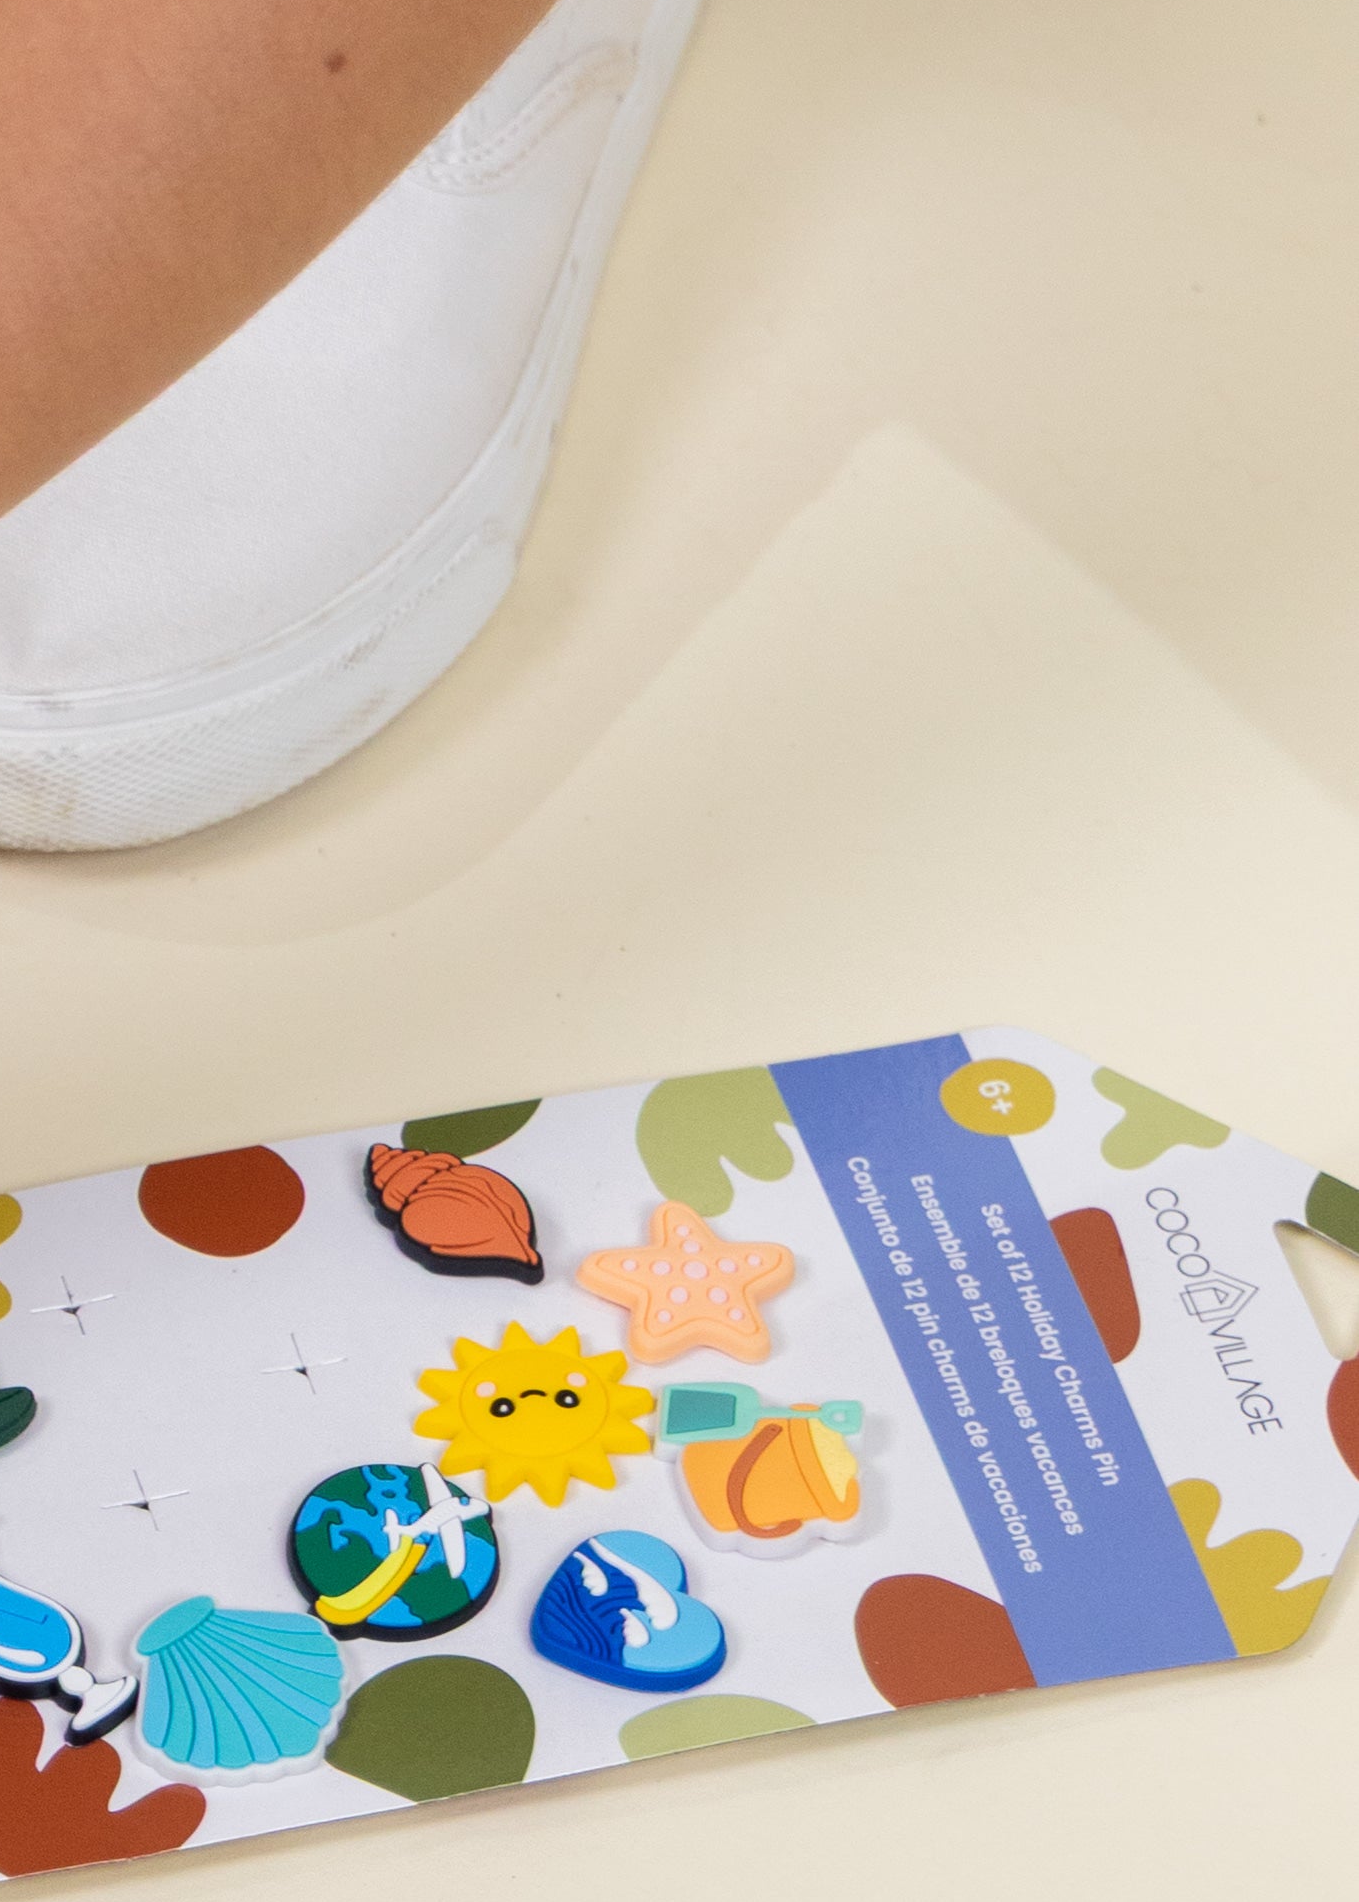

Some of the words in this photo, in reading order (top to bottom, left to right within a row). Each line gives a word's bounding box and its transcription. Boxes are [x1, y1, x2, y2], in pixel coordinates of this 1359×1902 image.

[978, 1080, 1013, 1115] 6+
[847, 1156, 901, 1247] Conjunto
[910, 1173, 968, 1271] Ensemble
[980, 1203, 1012, 1237] Set
[888, 1249, 914, 1276] de
[996, 1238, 1026, 1259] of
[900, 1277, 928, 1300] 12
[955, 1273, 981, 1301] de
[1006, 1261, 1034, 1283] 12
[903, 1301, 940, 1335] pin
[968, 1301, 996, 1324] 12
[1016, 1284, 1066, 1361] Holiday
[1144, 1186, 1211, 1278] COCO
[1208, 1317, 1283, 1435] VILLAGE
[926, 1337, 976, 1418] charms
[978, 1324, 1038, 1429] breloques
[1053, 1364, 1104, 1450] Charms
[963, 1420, 989, 1448] de
[1025, 1431, 1084, 1536] vacances
[1090, 1451, 1120, 1486] Pin
[976, 1450, 1043, 1574] vacaciones
